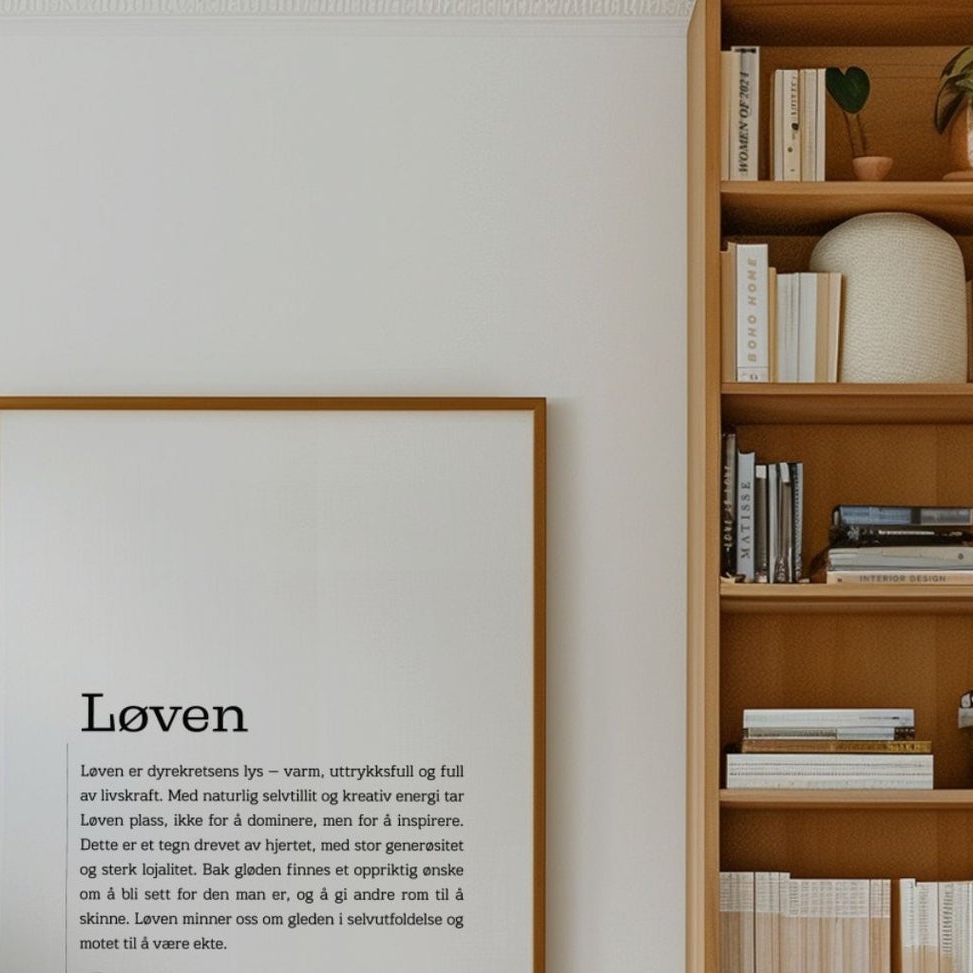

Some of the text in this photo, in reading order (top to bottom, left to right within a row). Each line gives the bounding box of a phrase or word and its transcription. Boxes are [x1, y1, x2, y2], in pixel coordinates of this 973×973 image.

[737, 100, 749, 119] OF
[737, 121, 749, 173] WOMEN
[747, 256, 758, 363] BOHO HOME
[740, 481, 751, 559] MATISSE
[859, 574, 947, 583] INTERIOR DESIGN
[80, 692, 249, 734] Løven
[80, 763, 125, 778] Løven
[128, 767, 144, 778] er
[146, 764, 240, 781] dyrekretsens
[243, 764, 264, 781] lys
[283, 767, 325, 779] varm,
[329, 764, 415, 781] uttrykksfull
[418, 767, 437, 781] og
[440, 764, 465, 778] full
[79, 788, 465, 806] av livskraft. Med naturlig selvtillit og kreativ energi tar
[80, 812, 464, 831] Løven plass, ikke for å dominere, men for å inspirere.
[80, 837, 465, 856] Dette er et tegn drevet av hjertet, med stor generøsitet
[79, 862, 465, 880] og sterk lojalitet. Bak gløden finnes et oppriktig ønske
[79, 886, 465, 905] om å bli sett for den man er, og å gi andre rom til å
[79, 911, 465, 930] skinne. Løven minner oss om gleden i selvutfoldelse og
[79, 935, 228, 950] motet til å være ekte.
